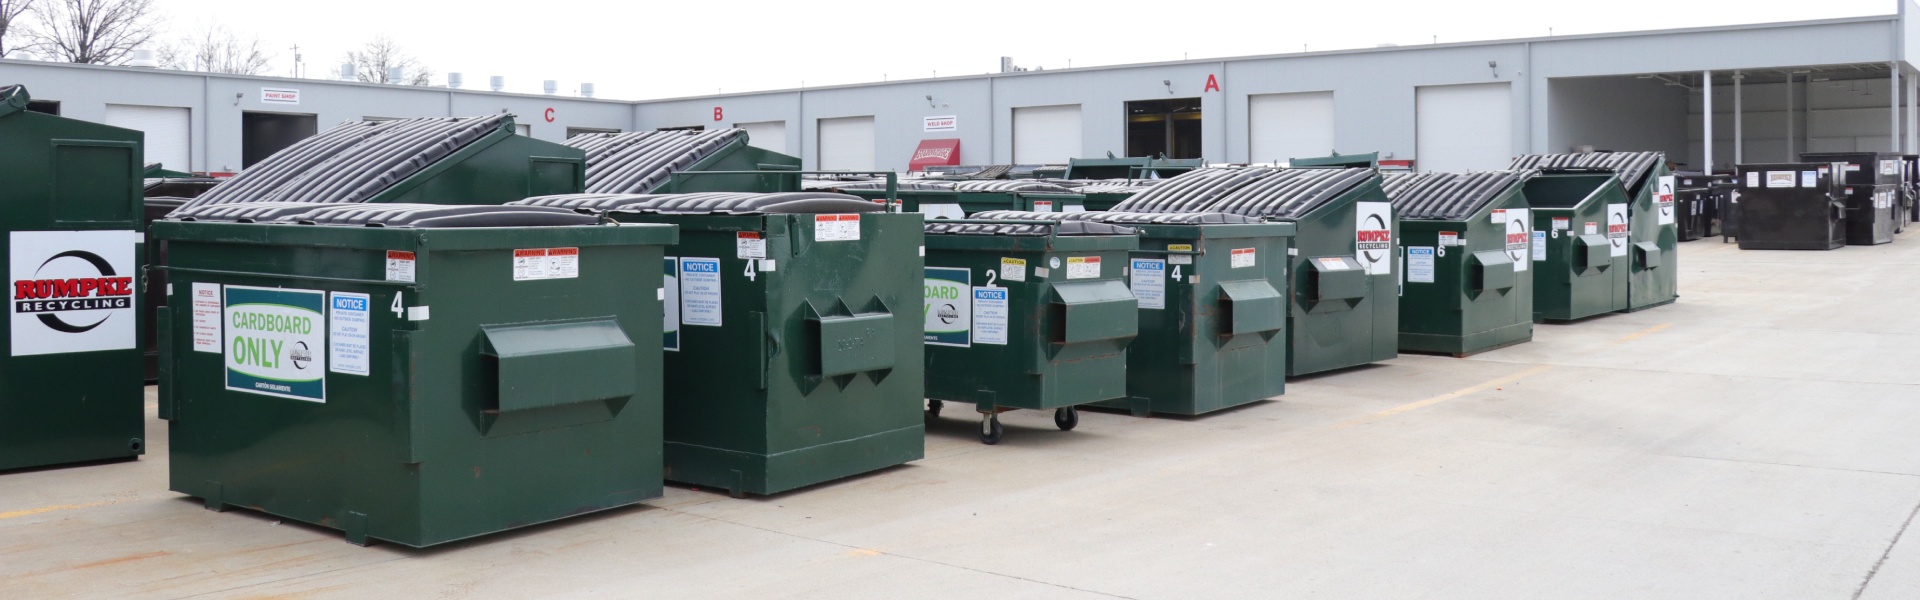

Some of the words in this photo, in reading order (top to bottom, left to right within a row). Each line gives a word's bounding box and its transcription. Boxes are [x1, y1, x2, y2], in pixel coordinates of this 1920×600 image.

[1204, 74, 1220, 92] A
[544, 108, 555, 122] C
[713, 107, 723, 121] B
[1357, 230, 1390, 242] RUMPKE
[1551, 229, 1558, 238] 6
[1437, 245, 1445, 257] 6
[687, 262, 714, 272] NOTICE
[744, 259, 756, 281] 4
[1171, 265, 1182, 281] 4
[986, 269, 996, 287] 2
[14, 277, 132, 299] RUMPKE
[978, 291, 1002, 299] NOTICE
[22, 299, 125, 311] RECYCLING
[336, 298, 363, 310] NOTICE
[391, 291, 404, 318] 4
[232, 311, 312, 334] CARDBOARD
[233, 336, 283, 368] ONLY
